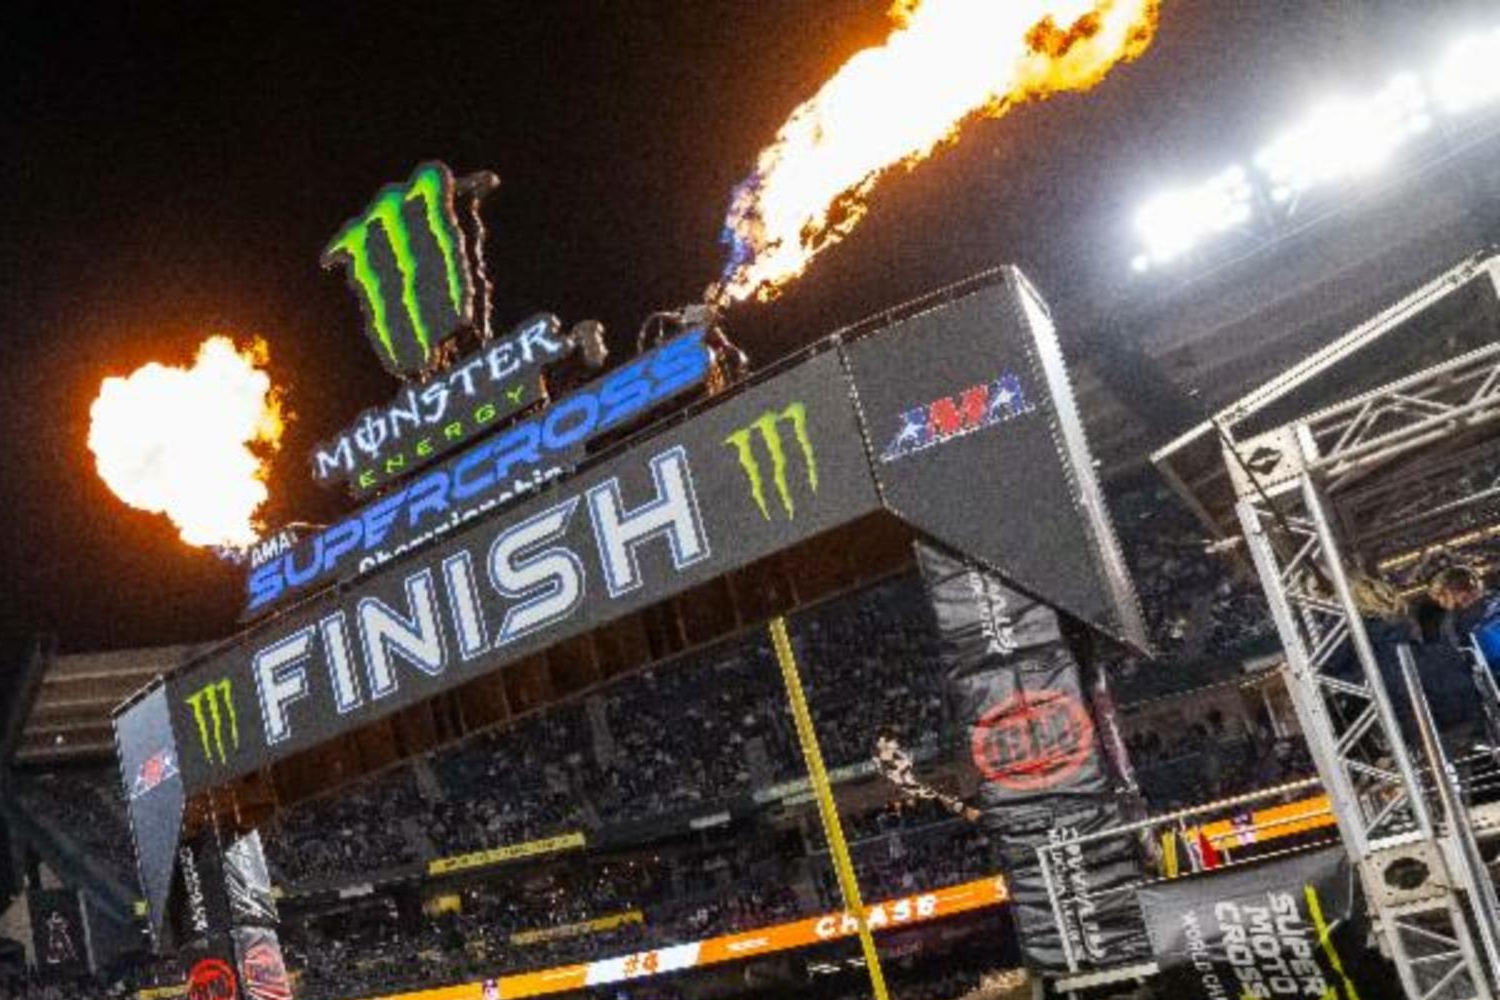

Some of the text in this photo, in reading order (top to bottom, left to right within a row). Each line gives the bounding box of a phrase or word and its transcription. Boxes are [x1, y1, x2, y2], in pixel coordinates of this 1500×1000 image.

[316, 319, 562, 478] MONSTER
[359, 385, 524, 489] ENERGY
[248, 323, 711, 610] SUPERCROSS
[252, 444, 710, 746] FINISH
[1214, 901, 1272, 1000] CROSS
[1242, 904, 1299, 995] MOTO
[1267, 890, 1329, 997] SUPER
